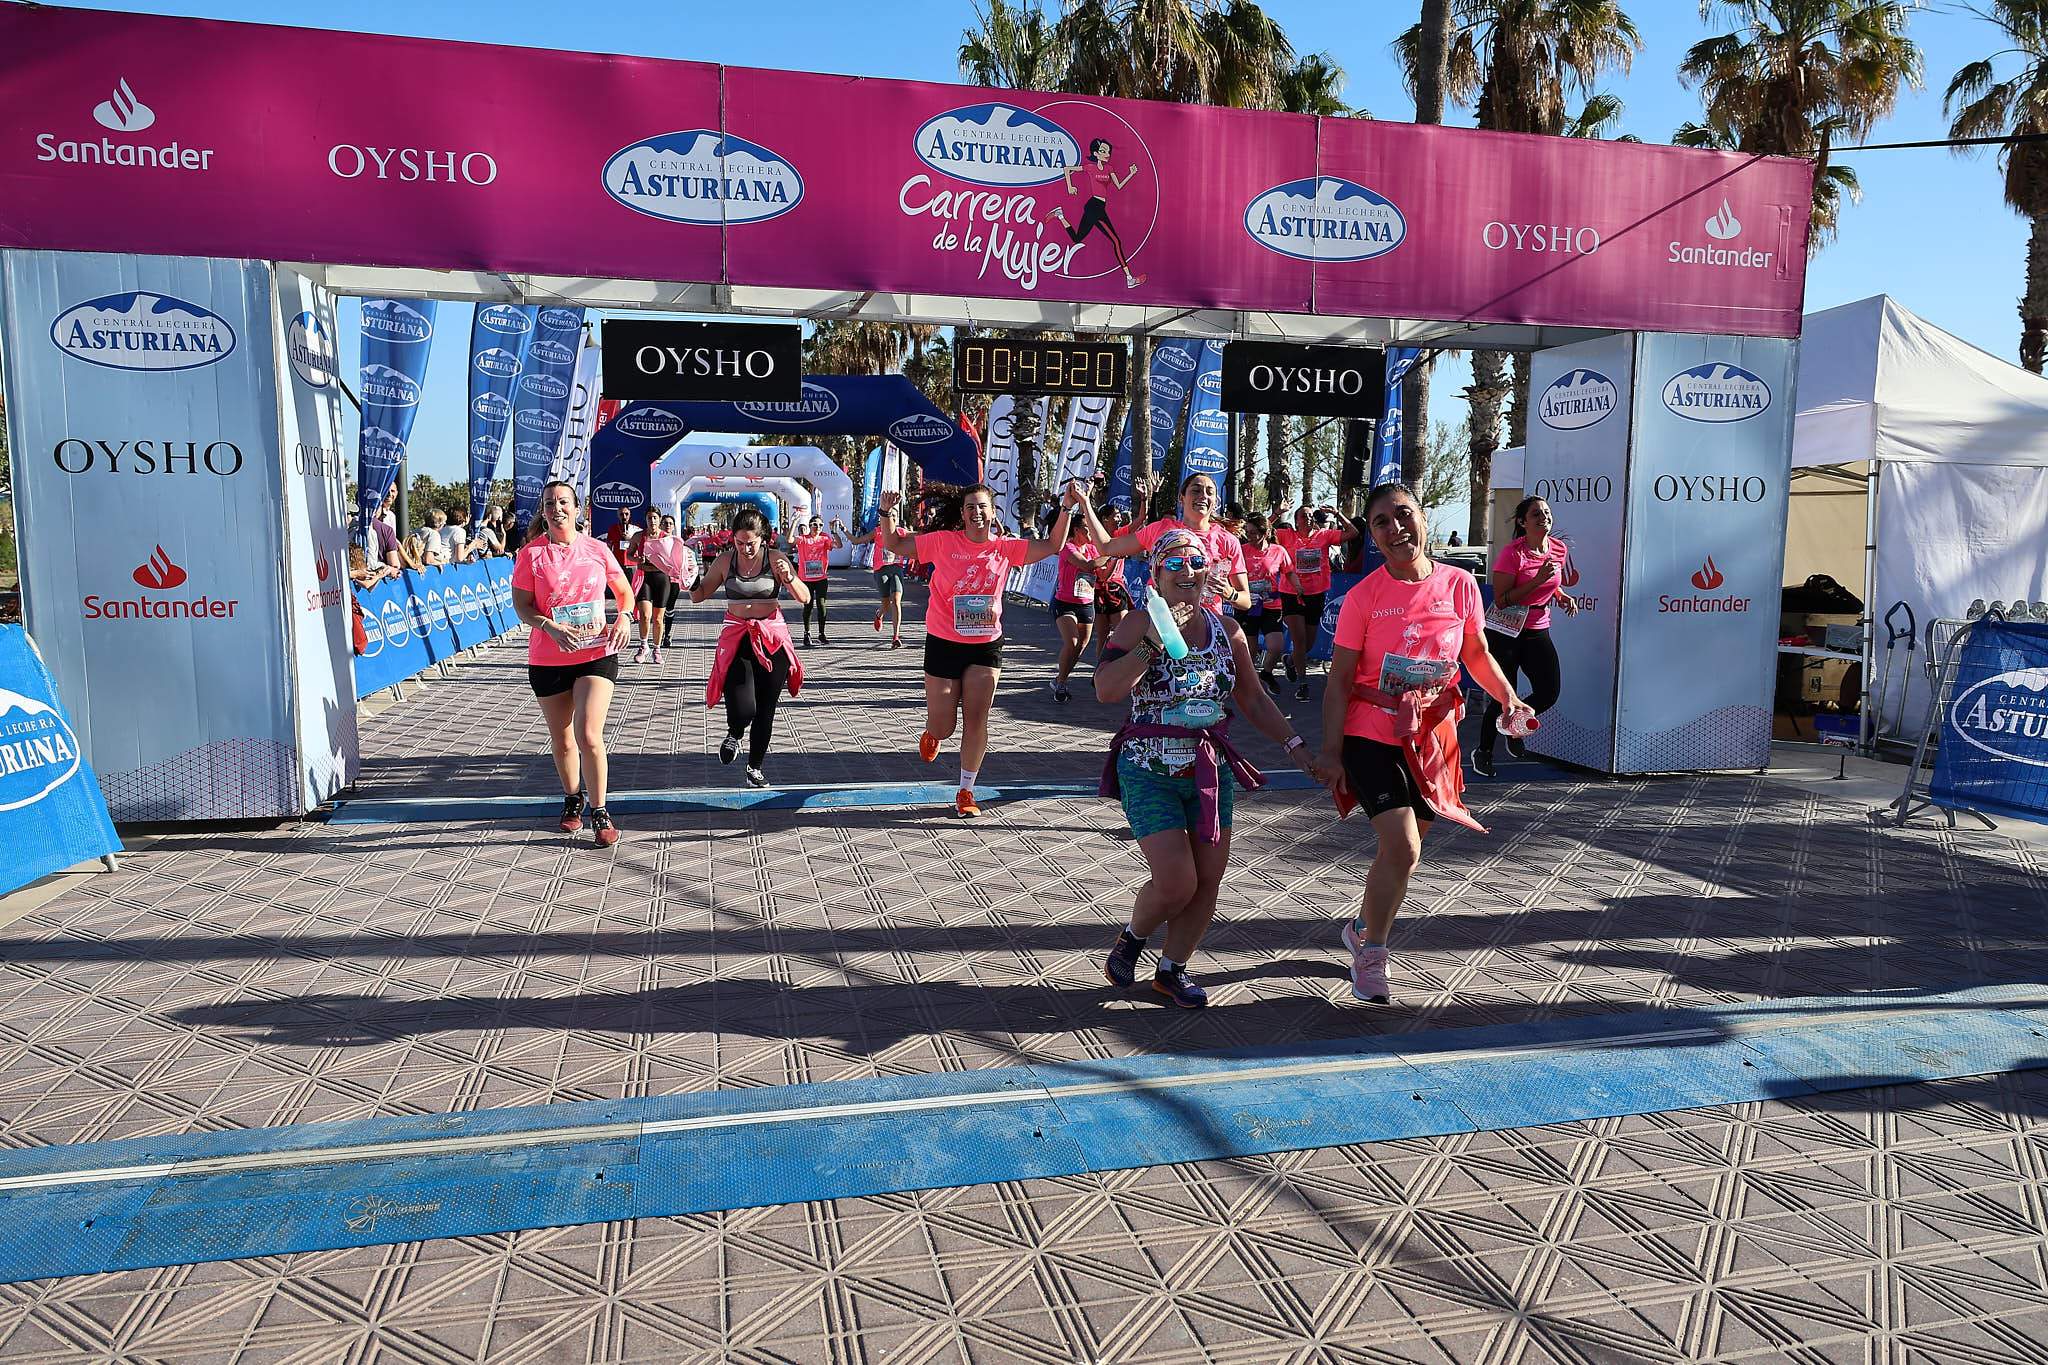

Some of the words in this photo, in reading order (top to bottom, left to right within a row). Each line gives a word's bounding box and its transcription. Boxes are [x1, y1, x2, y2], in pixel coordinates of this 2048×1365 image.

[926, 128, 1067, 169] ASTURIANA
[953, 128, 1005, 140] CENTRAL
[1010, 133, 1064, 145] LECHERA
[36, 133, 213, 171] Santander
[328, 144, 497, 186] OYSHO
[648, 159, 713, 173] CENTRAL
[619, 160, 788, 204] ASTURIANA
[900, 175, 1035, 225] Carrera
[1282, 202, 1332, 214] CENTRAL
[1337, 206, 1390, 219] LECHERA
[1256, 203, 1393, 243] ASTURIANA
[932, 227, 960, 251] de
[963, 229, 982, 252] la
[1482, 221, 1600, 255] OYSHO
[977, 222, 1085, 290] Mujer
[1668, 241, 1773, 268] Santander
[93, 318, 152, 328] CENTRAL
[158, 320, 216, 330] LECHERA
[482, 311, 526, 331] ASTURIANA
[66, 319, 223, 353] ASTURIANA
[635, 345, 775, 378] OYSHO
[966, 347, 1114, 387] 00:43:20
[1159, 351, 1195, 370] ASTURIANA
[523, 379, 565, 395] ASTURIANA
[1249, 365, 1363, 395] OYSHO
[1687, 382, 1722, 390] CENTRAL
[1554, 388, 1582, 399] CENTRAL
[1669, 383, 1763, 410] ASTURIANA
[1542, 394, 1611, 418] ASTURIANA
[620, 416, 678, 432] ASTURIANA
[894, 422, 950, 438] ASTURIANA
[54, 439, 243, 476] OYSHO
[295, 443, 339, 479] OYSHO
[709, 451, 791, 469] OYSHO
[595, 488, 641, 504] ASTURIANA
[1534, 475, 1612, 503] OYSHO
[1653, 474, 1767, 503] OYSHO
[84, 595, 239, 619] Santander
[1371, 607, 1405, 619] OYSHO
[1658, 594, 1751, 613] Santander
[1999, 694, 2048, 708] CENTR
[6, 718, 56, 736] LECHERA
